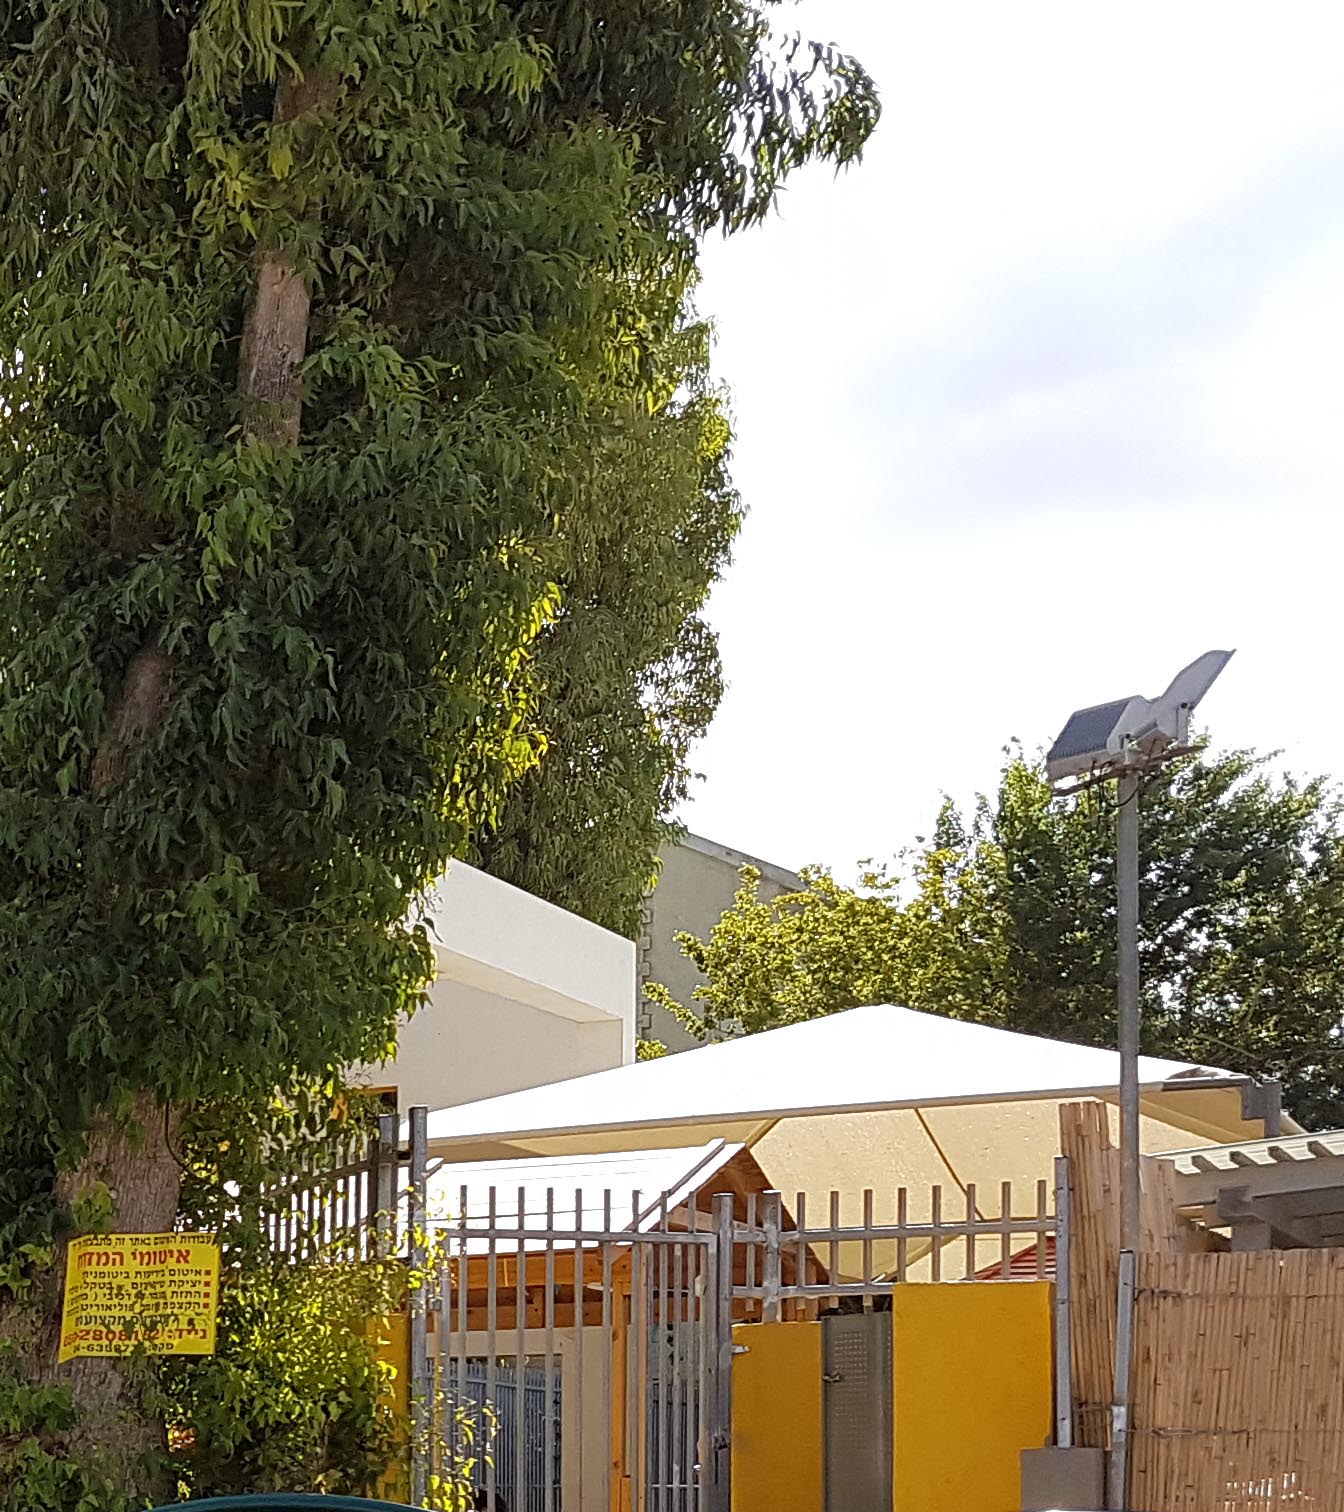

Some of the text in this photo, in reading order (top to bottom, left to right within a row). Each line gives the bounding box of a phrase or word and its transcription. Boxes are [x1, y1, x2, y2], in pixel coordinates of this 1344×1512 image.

[130, 1249, 191, 1266] איטומי
[168, 1268, 202, 1277] איטום
[168, 1280, 202, 1290] יציקת
[171, 1290, 201, 1299] התזת
